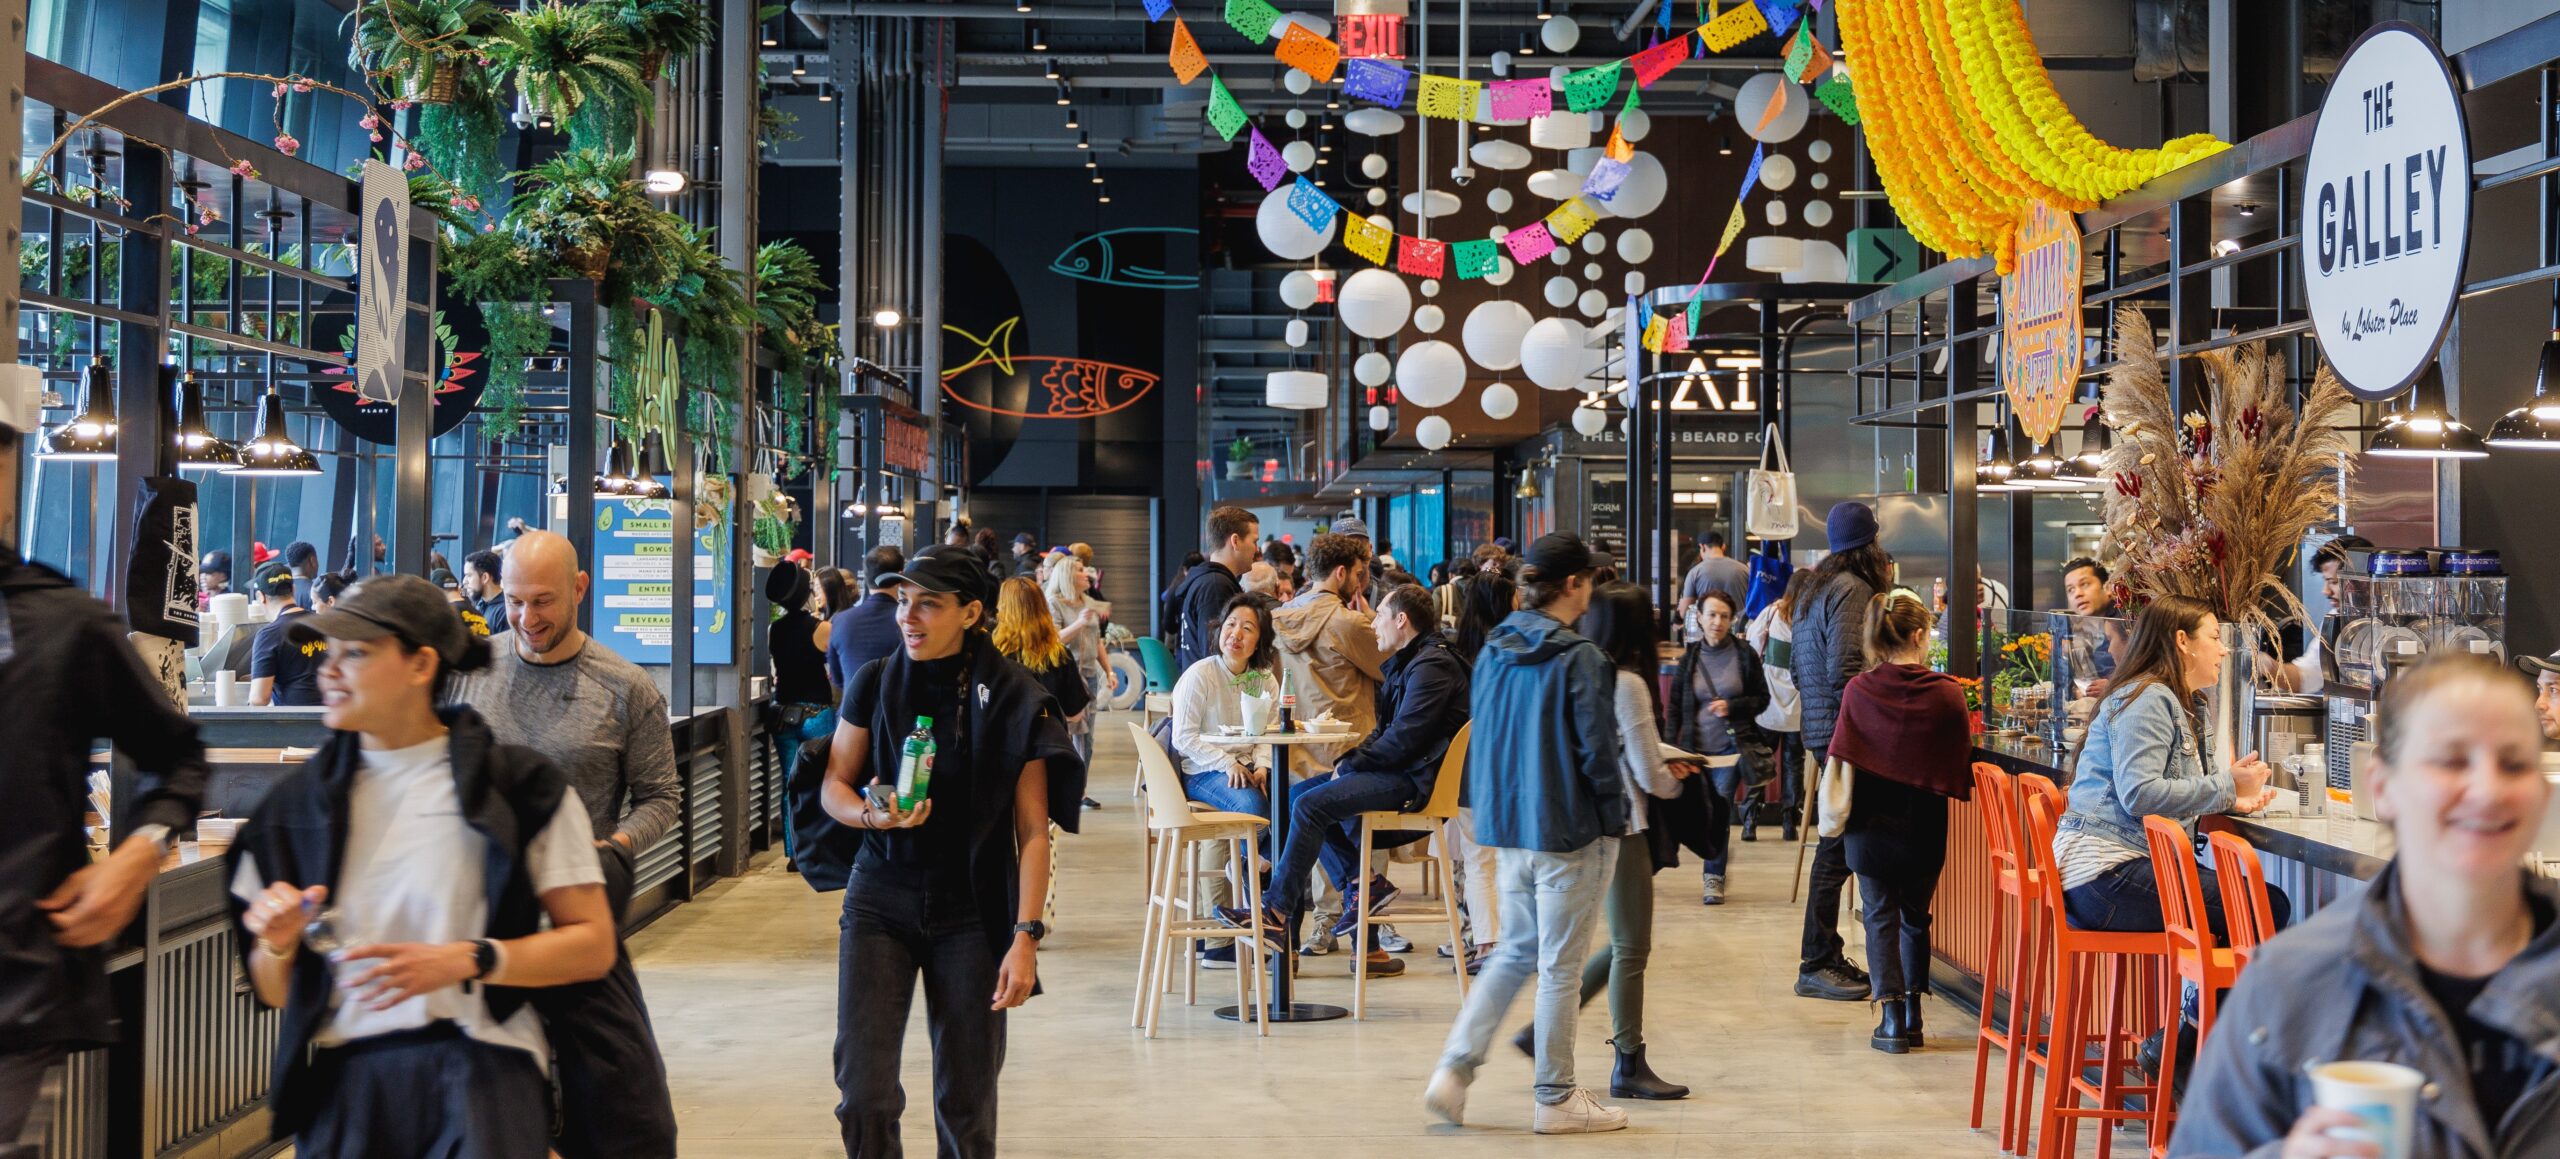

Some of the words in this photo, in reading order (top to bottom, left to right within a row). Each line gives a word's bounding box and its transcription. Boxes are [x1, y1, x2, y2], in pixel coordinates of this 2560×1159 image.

[1347, 15, 1400, 56] EXIT
[2362, 80, 2394, 135] THE
[2318, 144, 2447, 277] GALLEY
[2341, 309, 2351, 341] by
[2351, 306, 2386, 342] Lobster
[2388, 297, 2418, 335] Place
[1682, 431, 1739, 442] BEARD
